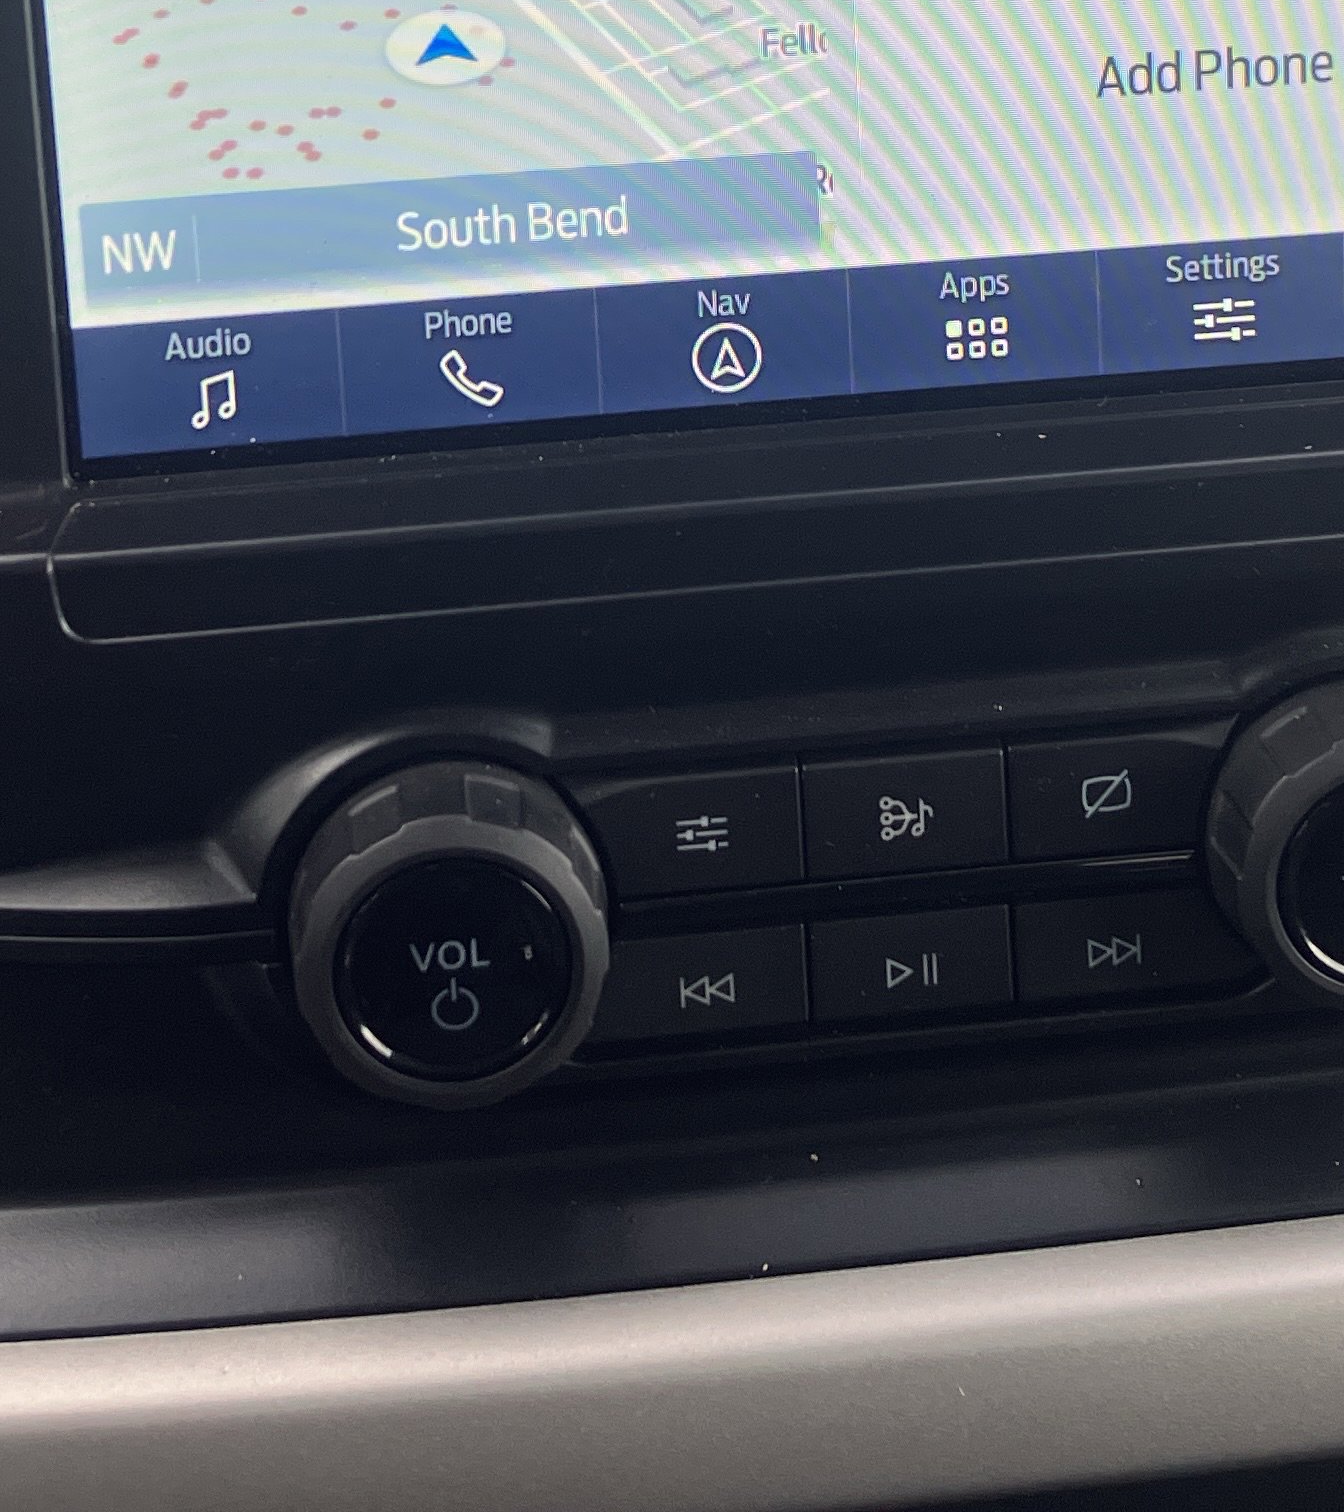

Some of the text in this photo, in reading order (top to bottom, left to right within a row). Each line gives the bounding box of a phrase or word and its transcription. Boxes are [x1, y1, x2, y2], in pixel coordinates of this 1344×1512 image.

[1097, 46, 1334, 100] Add Phone
[397, 196, 628, 253] South Bend
[102, 230, 177, 276] NW
[1165, 251, 1280, 288] Settings
[938, 271, 1011, 302] Apps
[697, 291, 751, 319] Nav
[424, 307, 513, 342] Phone
[164, 328, 252, 364] Audio
[408, 938, 490, 973] VOL
